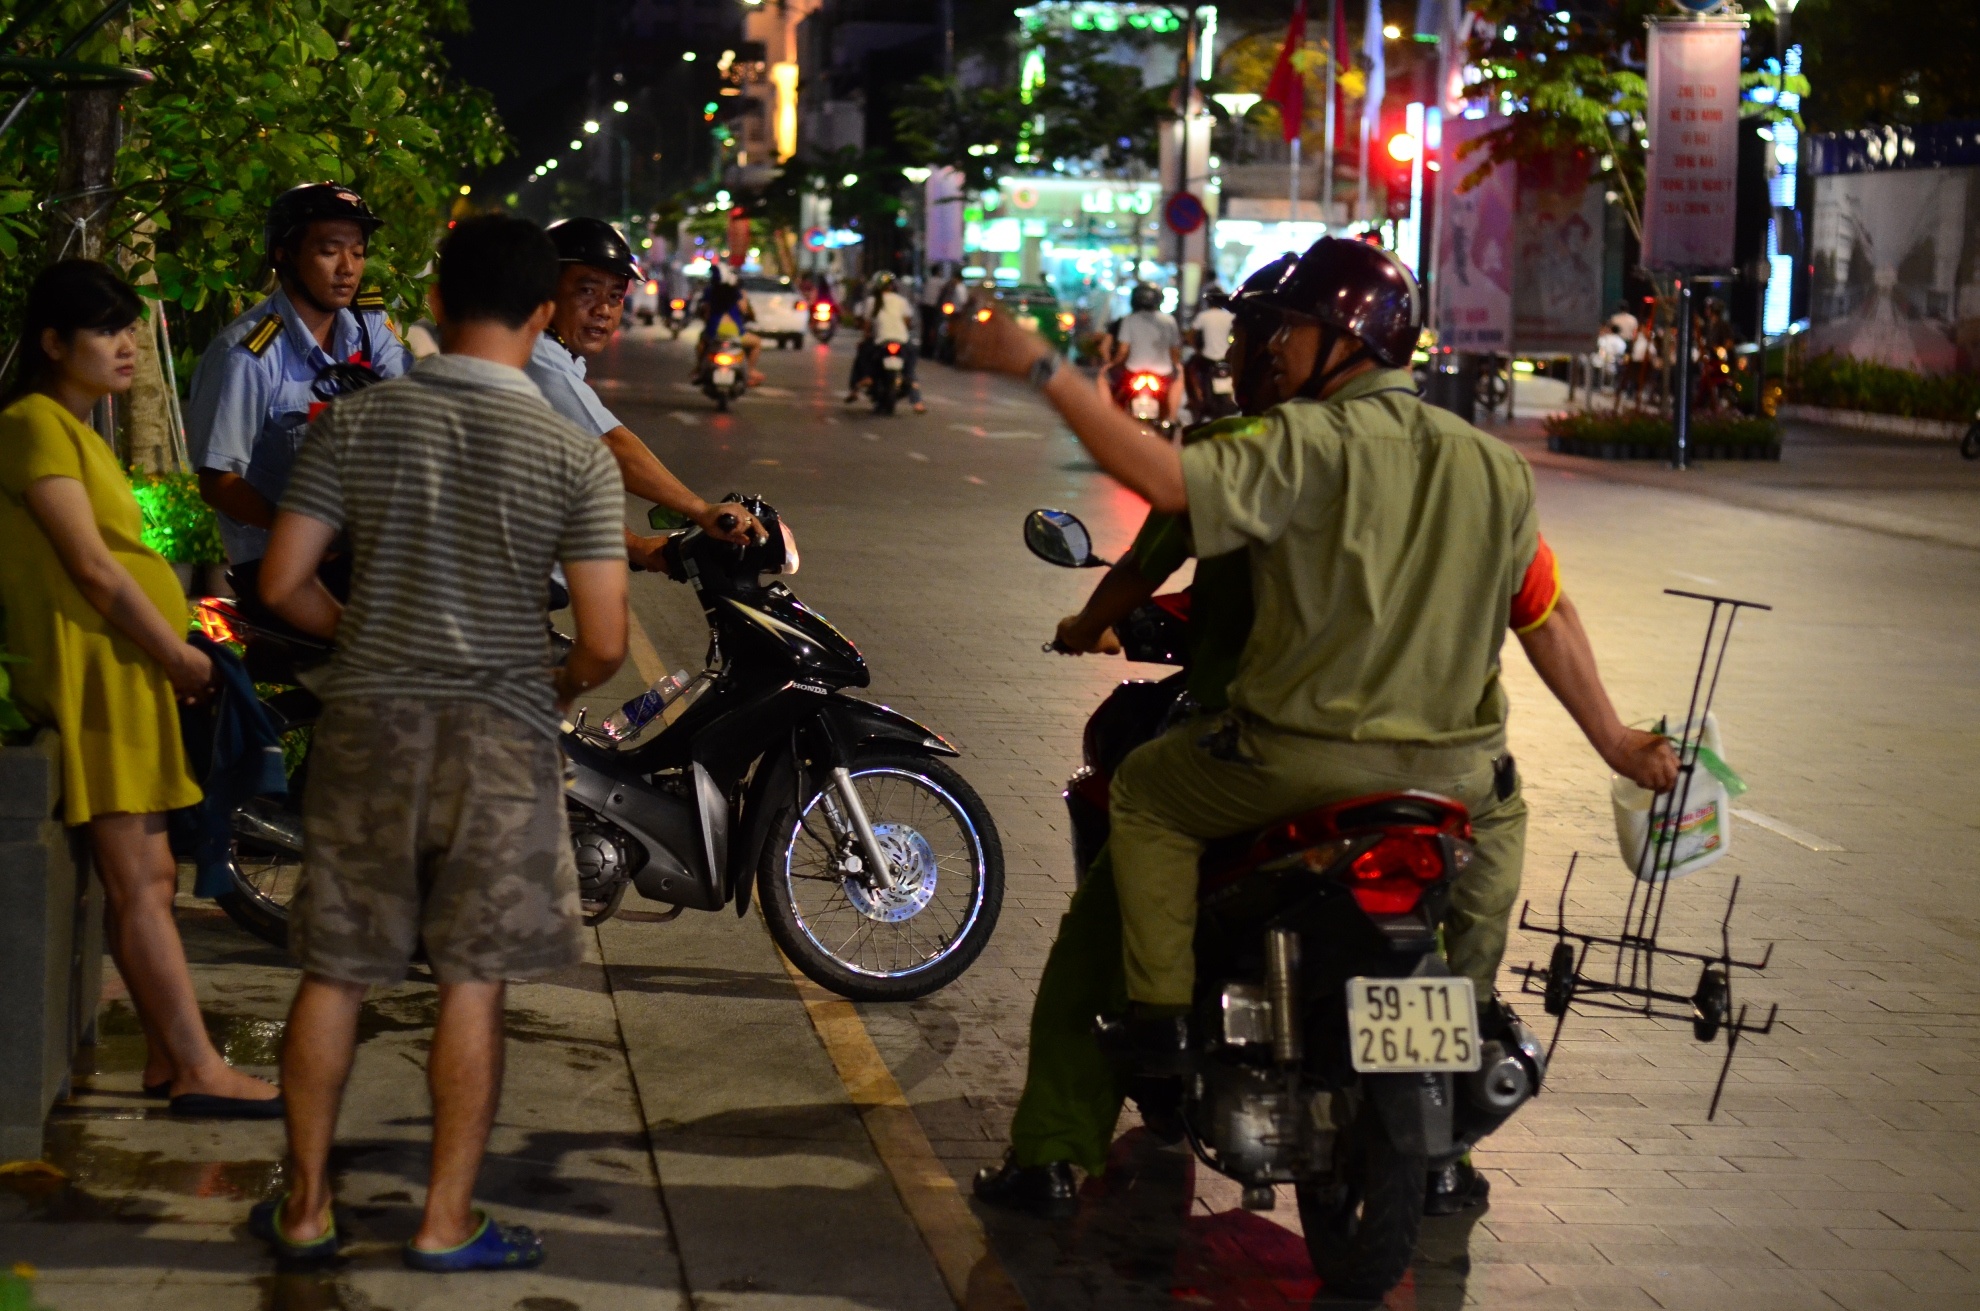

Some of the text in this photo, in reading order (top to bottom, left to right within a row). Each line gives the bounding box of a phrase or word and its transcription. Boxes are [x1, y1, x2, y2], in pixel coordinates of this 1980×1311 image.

[792, 682, 828, 695] HONDA
[1366, 985, 1452, 1022] 59-T1
[1358, 1027, 1471, 1064] 264.25
